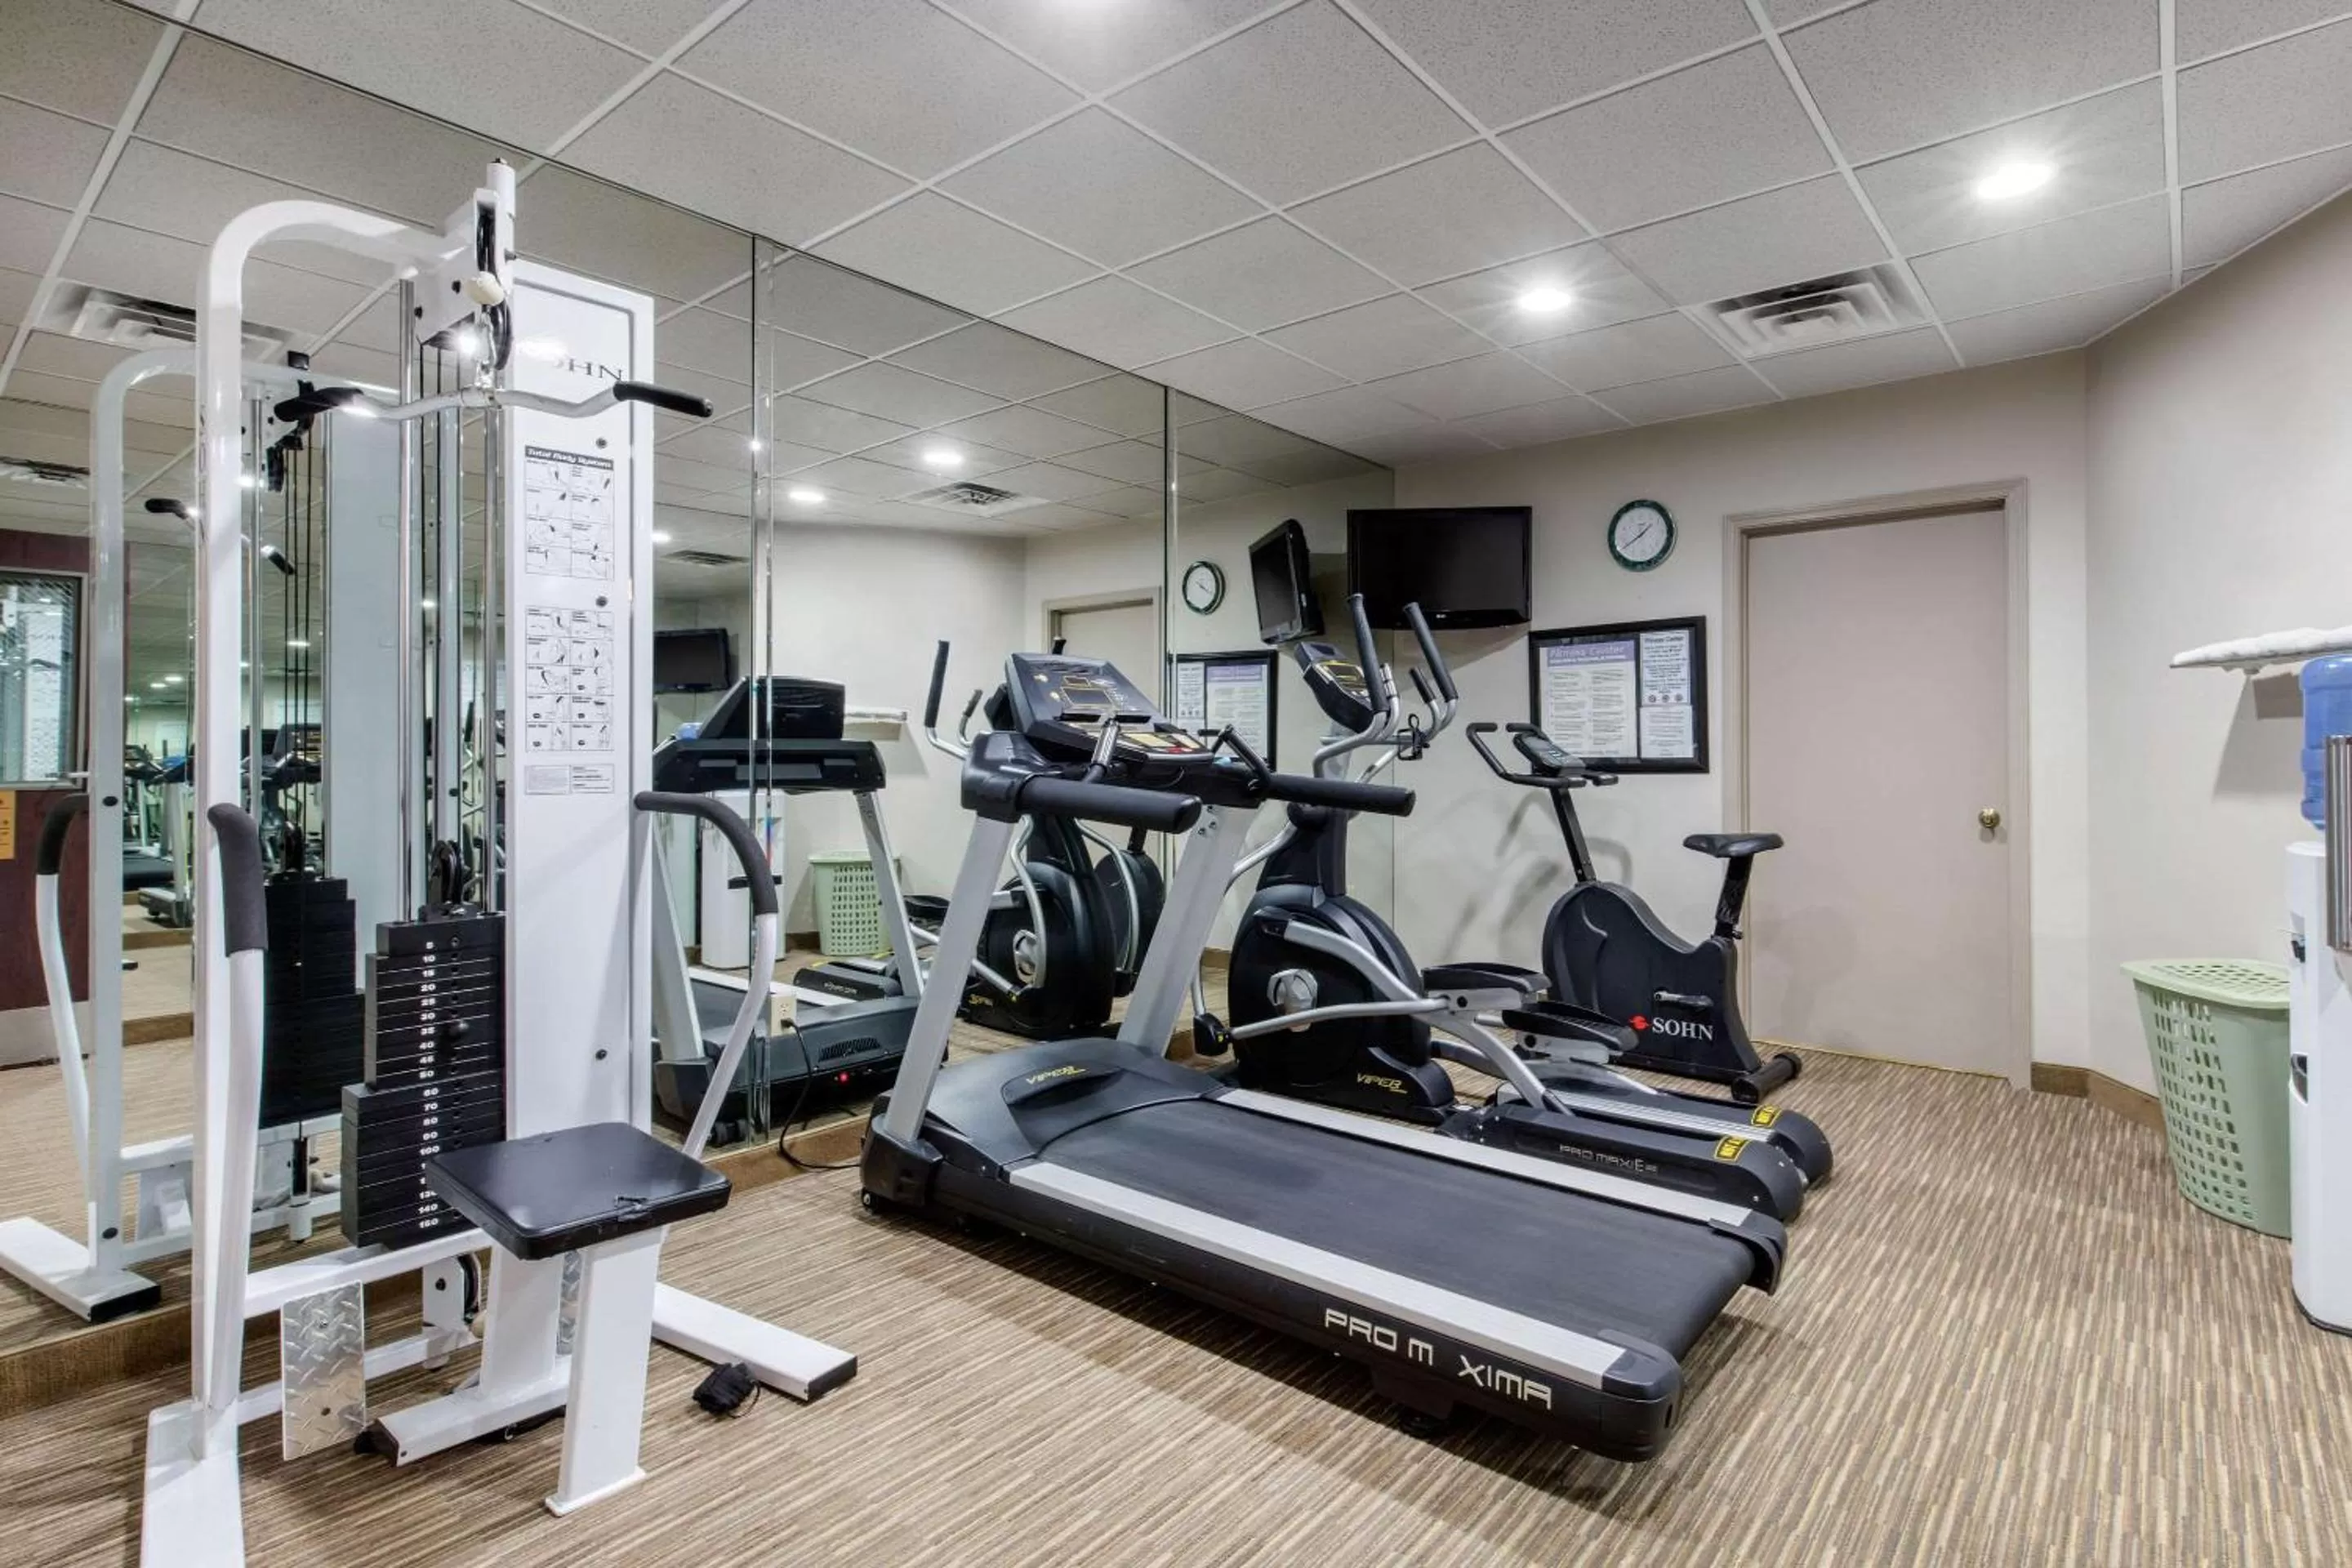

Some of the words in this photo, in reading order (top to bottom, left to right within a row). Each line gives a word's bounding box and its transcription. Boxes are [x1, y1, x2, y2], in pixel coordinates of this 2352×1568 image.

[422, 955, 436, 963] 10
[421, 969, 435, 977] 15
[421, 983, 436, 991] 20
[421, 997, 436, 1006] 25
[420, 1012, 435, 1021] 30
[420, 1027, 435, 1036] 35
[1652, 1017, 1713, 1040] SOHN
[419, 1040, 434, 1049] 40
[419, 1055, 434, 1063] 45
[419, 1070, 434, 1079] 50
[423, 1087, 439, 1097] 60
[424, 1102, 439, 1111] 70
[423, 1117, 439, 1126] 80
[420, 1146, 439, 1156] 100
[1559, 1143, 1594, 1160] PRO
[418, 1203, 438, 1214] 140
[1324, 1307, 1397, 1352] PRO
